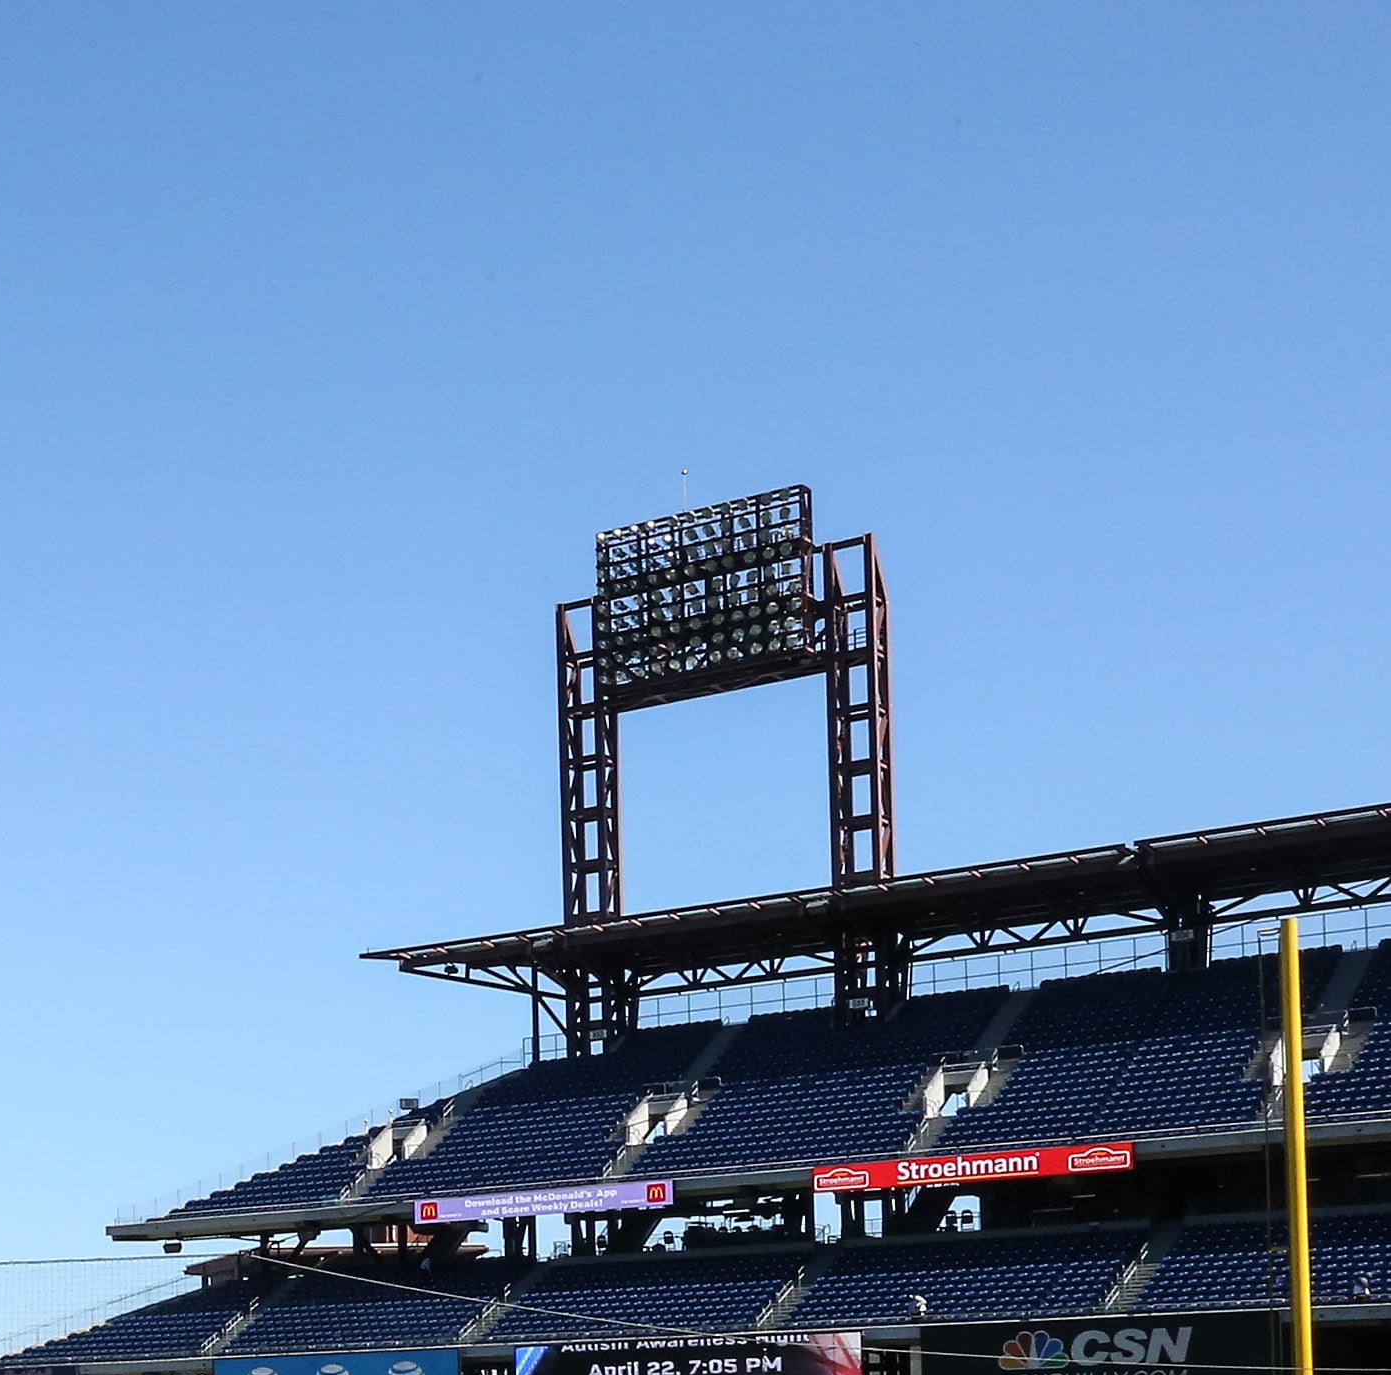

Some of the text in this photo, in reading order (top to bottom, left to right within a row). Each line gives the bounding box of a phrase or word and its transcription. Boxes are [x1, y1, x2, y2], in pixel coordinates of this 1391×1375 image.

[897, 1156, 1038, 1180] Stroehmann
[1073, 1154, 1126, 1166] Stroehmann
[465, 1188, 617, 1208] Download the McDonald's App
[481, 1198, 603, 1217] and Score Weekly Deals!
[1070, 1326, 1193, 1367] CSN
[688, 1358, 738, 1375] 7:05
[746, 1356, 782, 1374] PM
